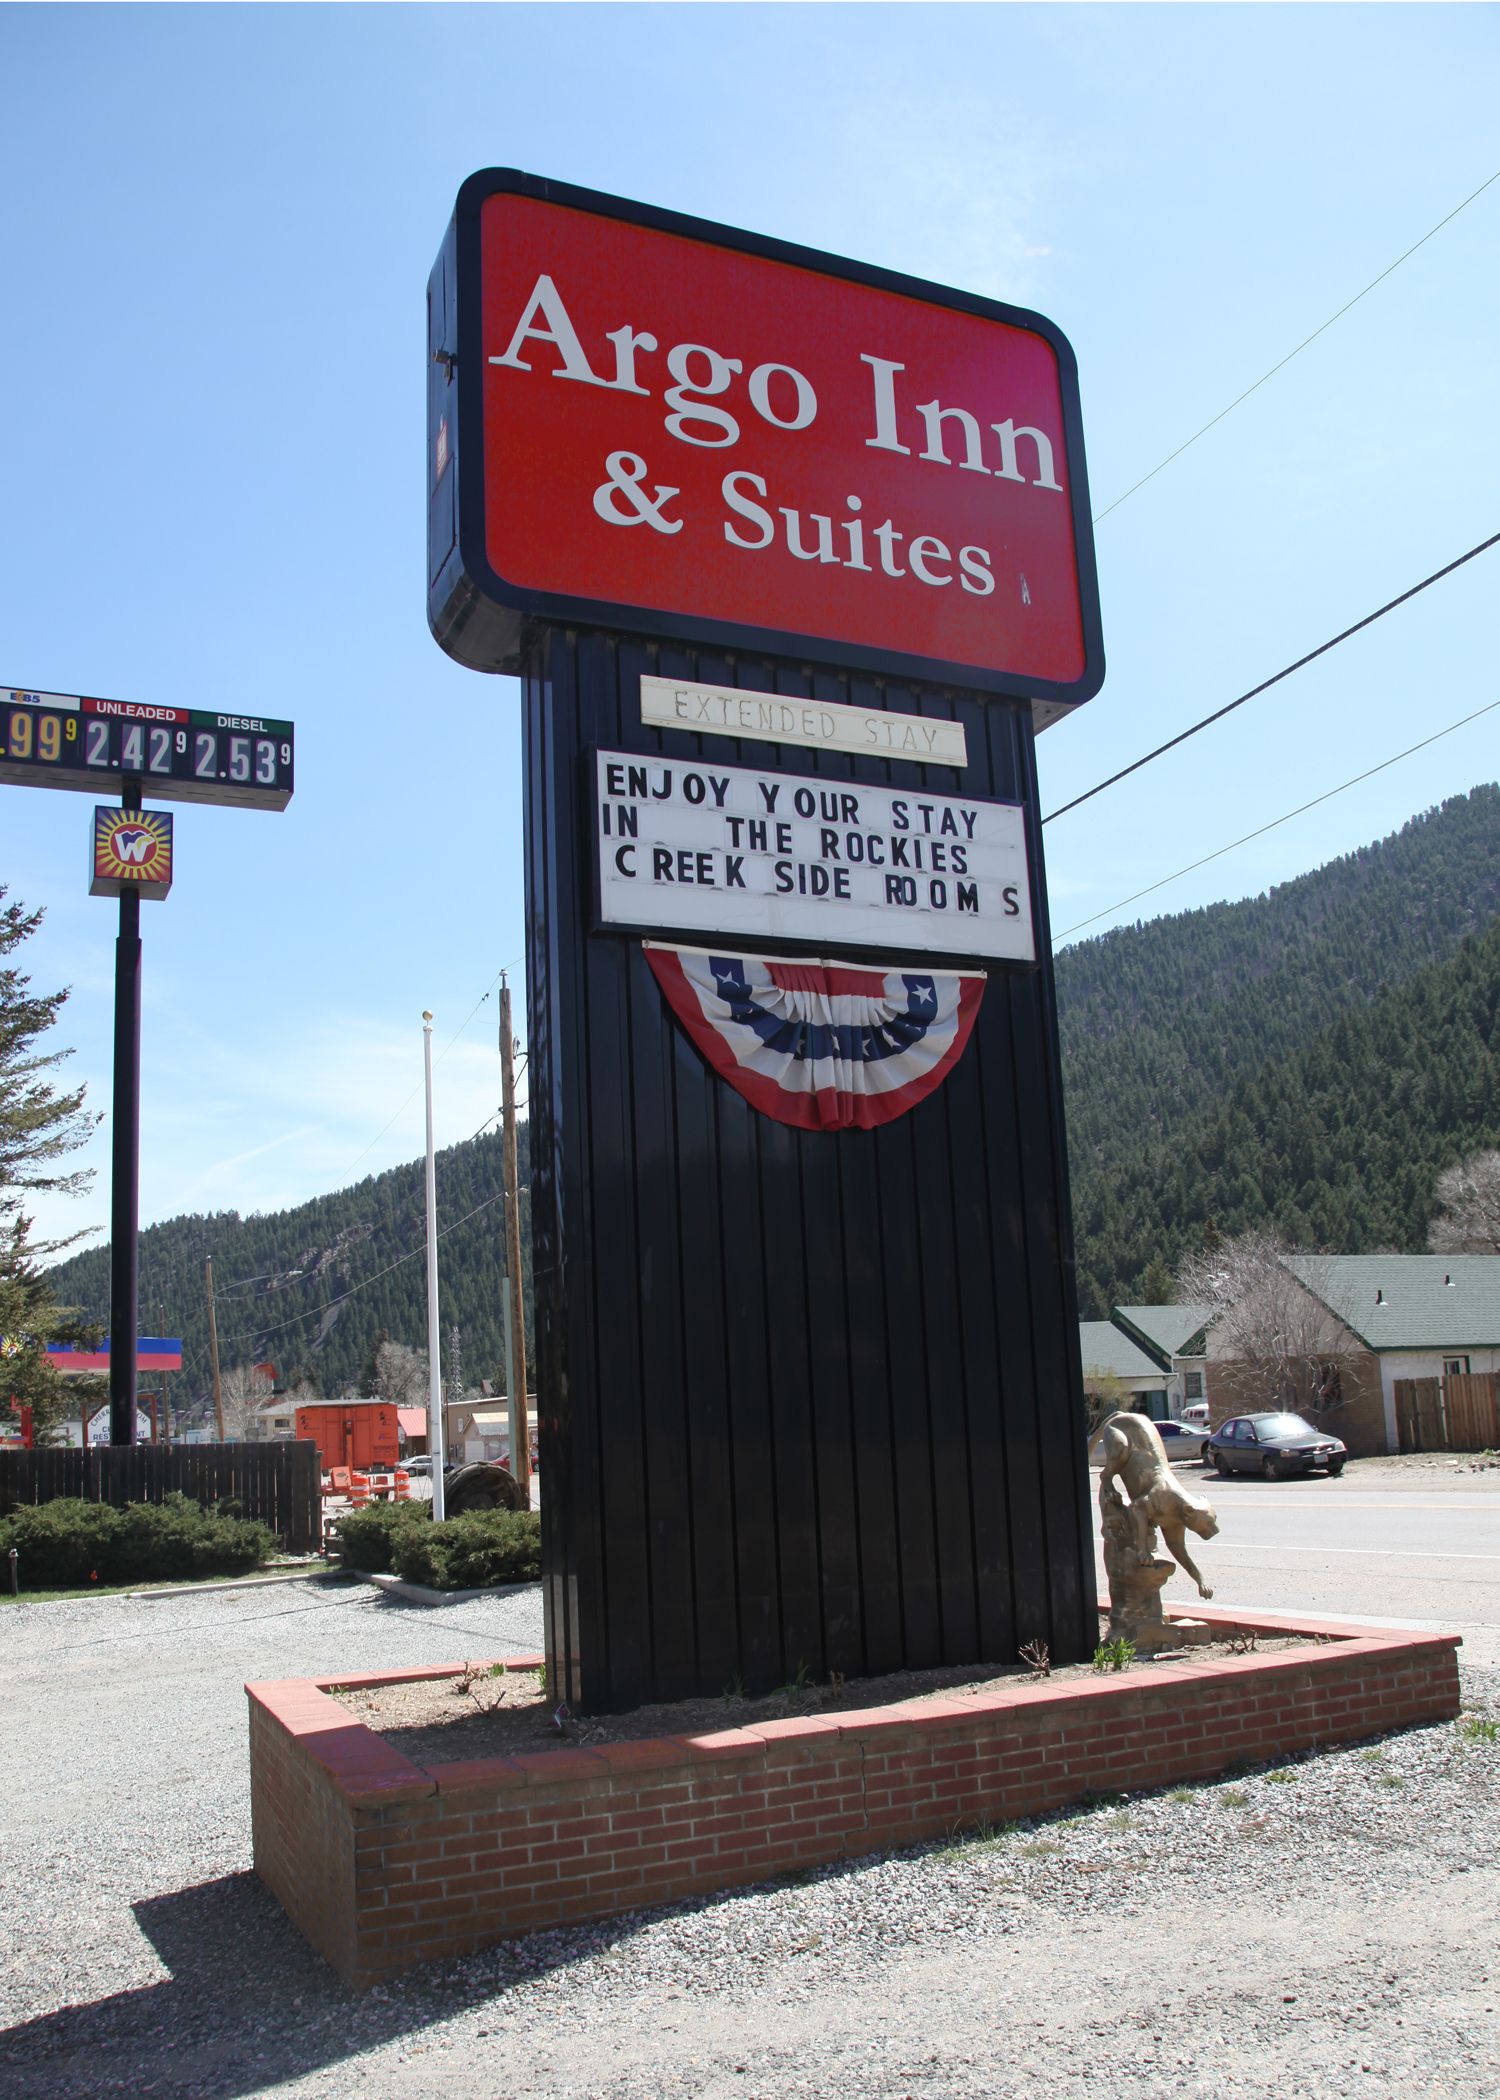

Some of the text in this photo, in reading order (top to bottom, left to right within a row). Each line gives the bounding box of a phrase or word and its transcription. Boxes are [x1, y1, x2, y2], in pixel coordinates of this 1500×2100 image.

[488, 273, 1064, 492] Argo Inn
[593, 450, 996, 596] & Suites
[96, 701, 176, 721] UNLEADED
[217, 715, 268, 732] DIESEL
[674, 690, 937, 752] EXTENDED STAY
[606, 763, 978, 840] ENJOY YOUR STAY
[602, 803, 968, 874] IN THE ROCKIES
[614, 844, 746, 888] CREEK
[774, 860, 852, 899] SIDE
